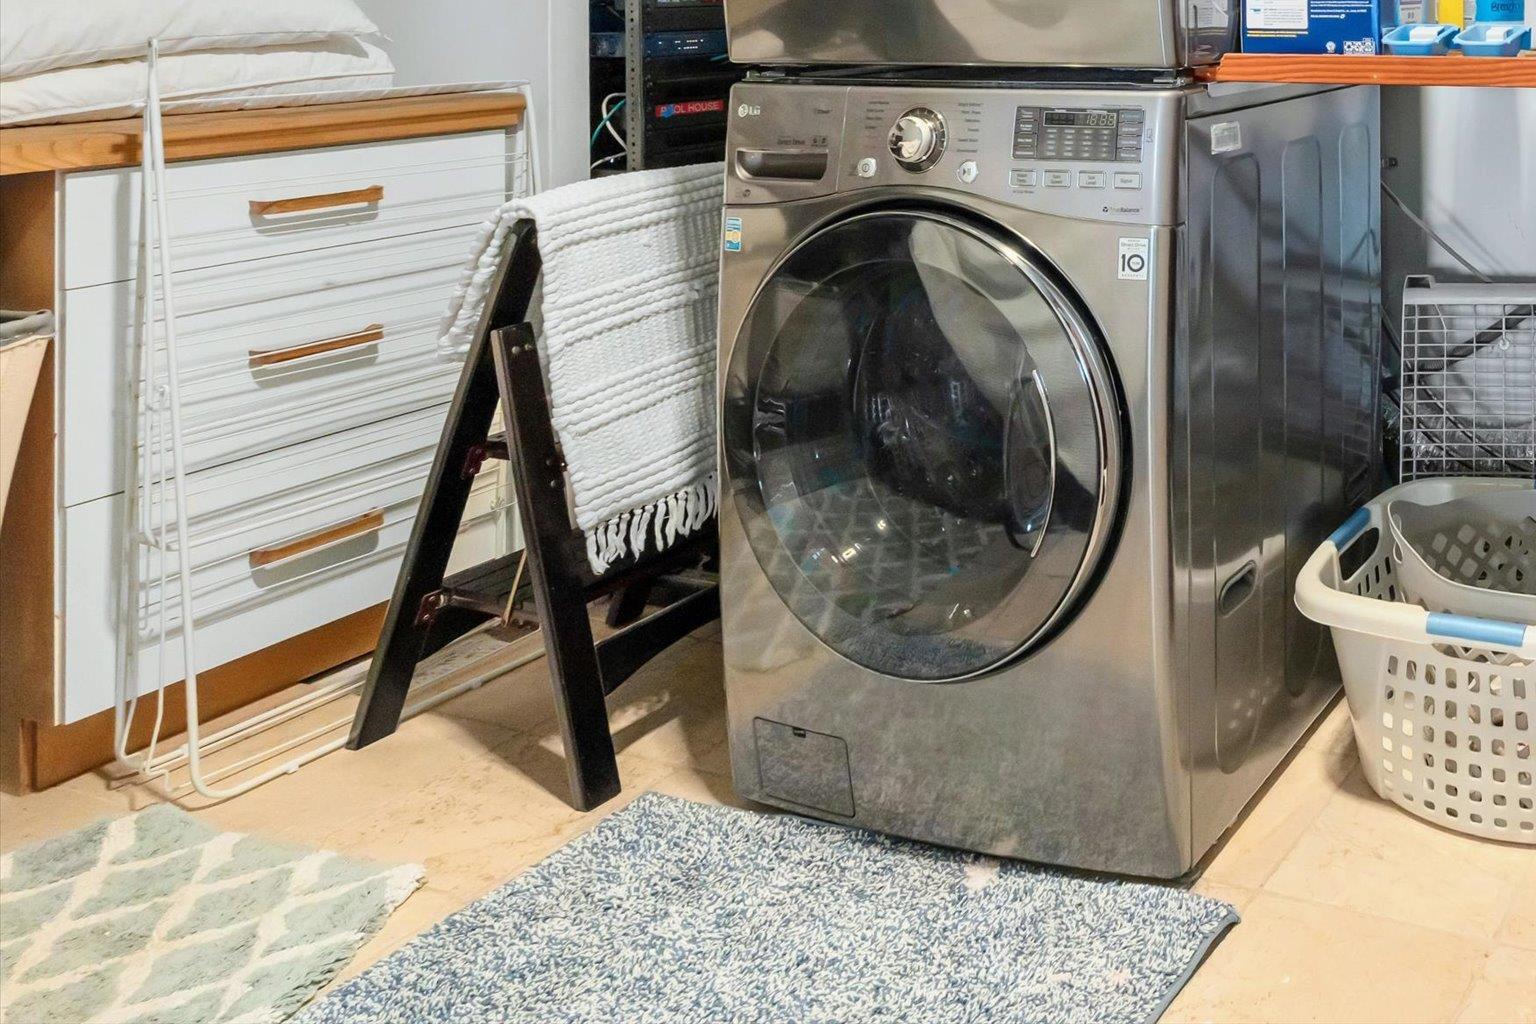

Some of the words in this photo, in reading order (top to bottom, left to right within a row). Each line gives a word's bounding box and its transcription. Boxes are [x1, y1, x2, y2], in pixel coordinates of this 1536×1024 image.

[660, 104, 687, 115] POL
[687, 101, 720, 113] HOUSE
[748, 105, 761, 116] LG
[1121, 253, 1145, 273] 10
